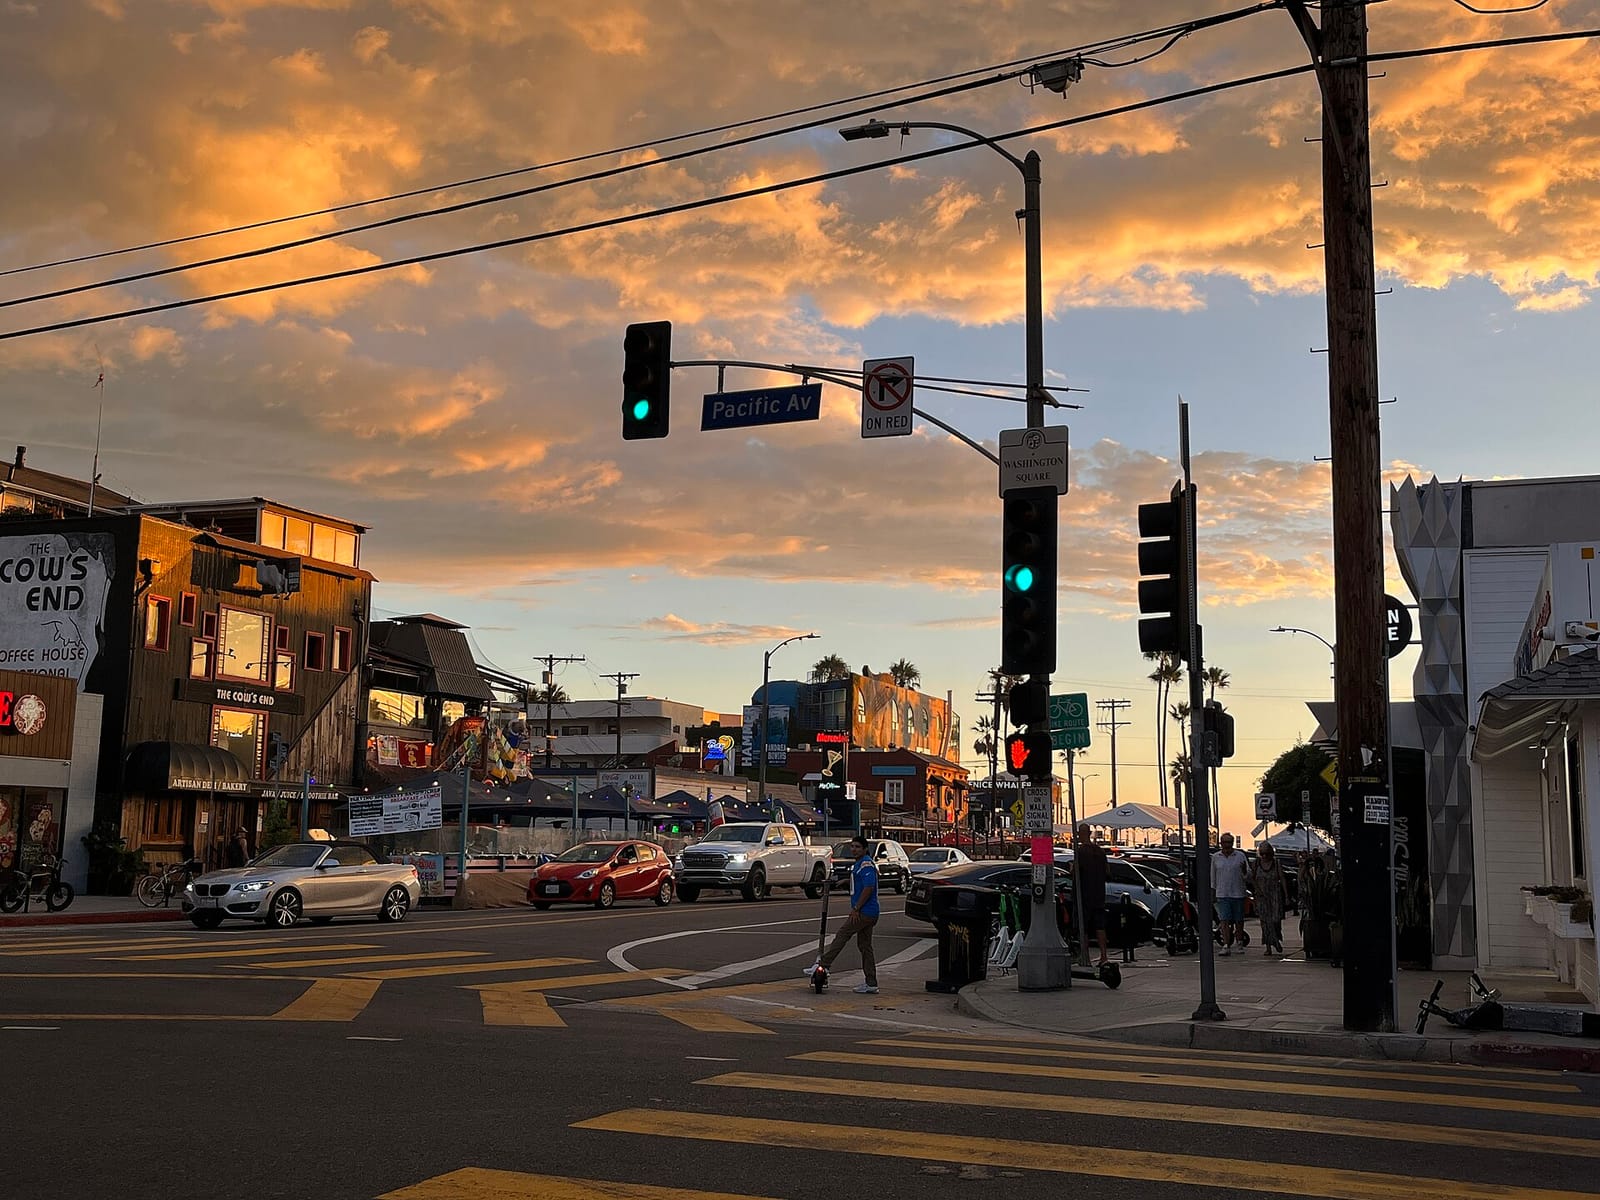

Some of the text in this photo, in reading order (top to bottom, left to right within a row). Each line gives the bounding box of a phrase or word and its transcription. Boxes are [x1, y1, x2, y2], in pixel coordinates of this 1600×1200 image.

[712, 393, 812, 419] Pacific Av
[866, 415, 908, 430] ON RED
[1003, 456, 1064, 469] WASHINGTON
[1016, 471, 1051, 483] SQUARE
[29, 543, 50, 554] THE
[0, 553, 88, 583] COW'S
[27, 585, 84, 611] END
[1387, 609, 1400, 624] N
[1387, 626, 1400, 641] E
[0, 647, 85, 662] OFFEE HOUSE
[217, 689, 275, 706] THE COW'S END
[1051, 719, 1085, 728] IKE ROUTE
[1051, 731, 1086, 746] BEGIN
[172, 779, 201, 788] ARTISAN
[202, 781, 217, 789] DEI
[222, 782, 248, 791] BAKERY
[1027, 788, 1048, 796] CROSS
[1026, 812, 1049, 820] SIGNAL
[1028, 820, 1046, 828] ONLY
